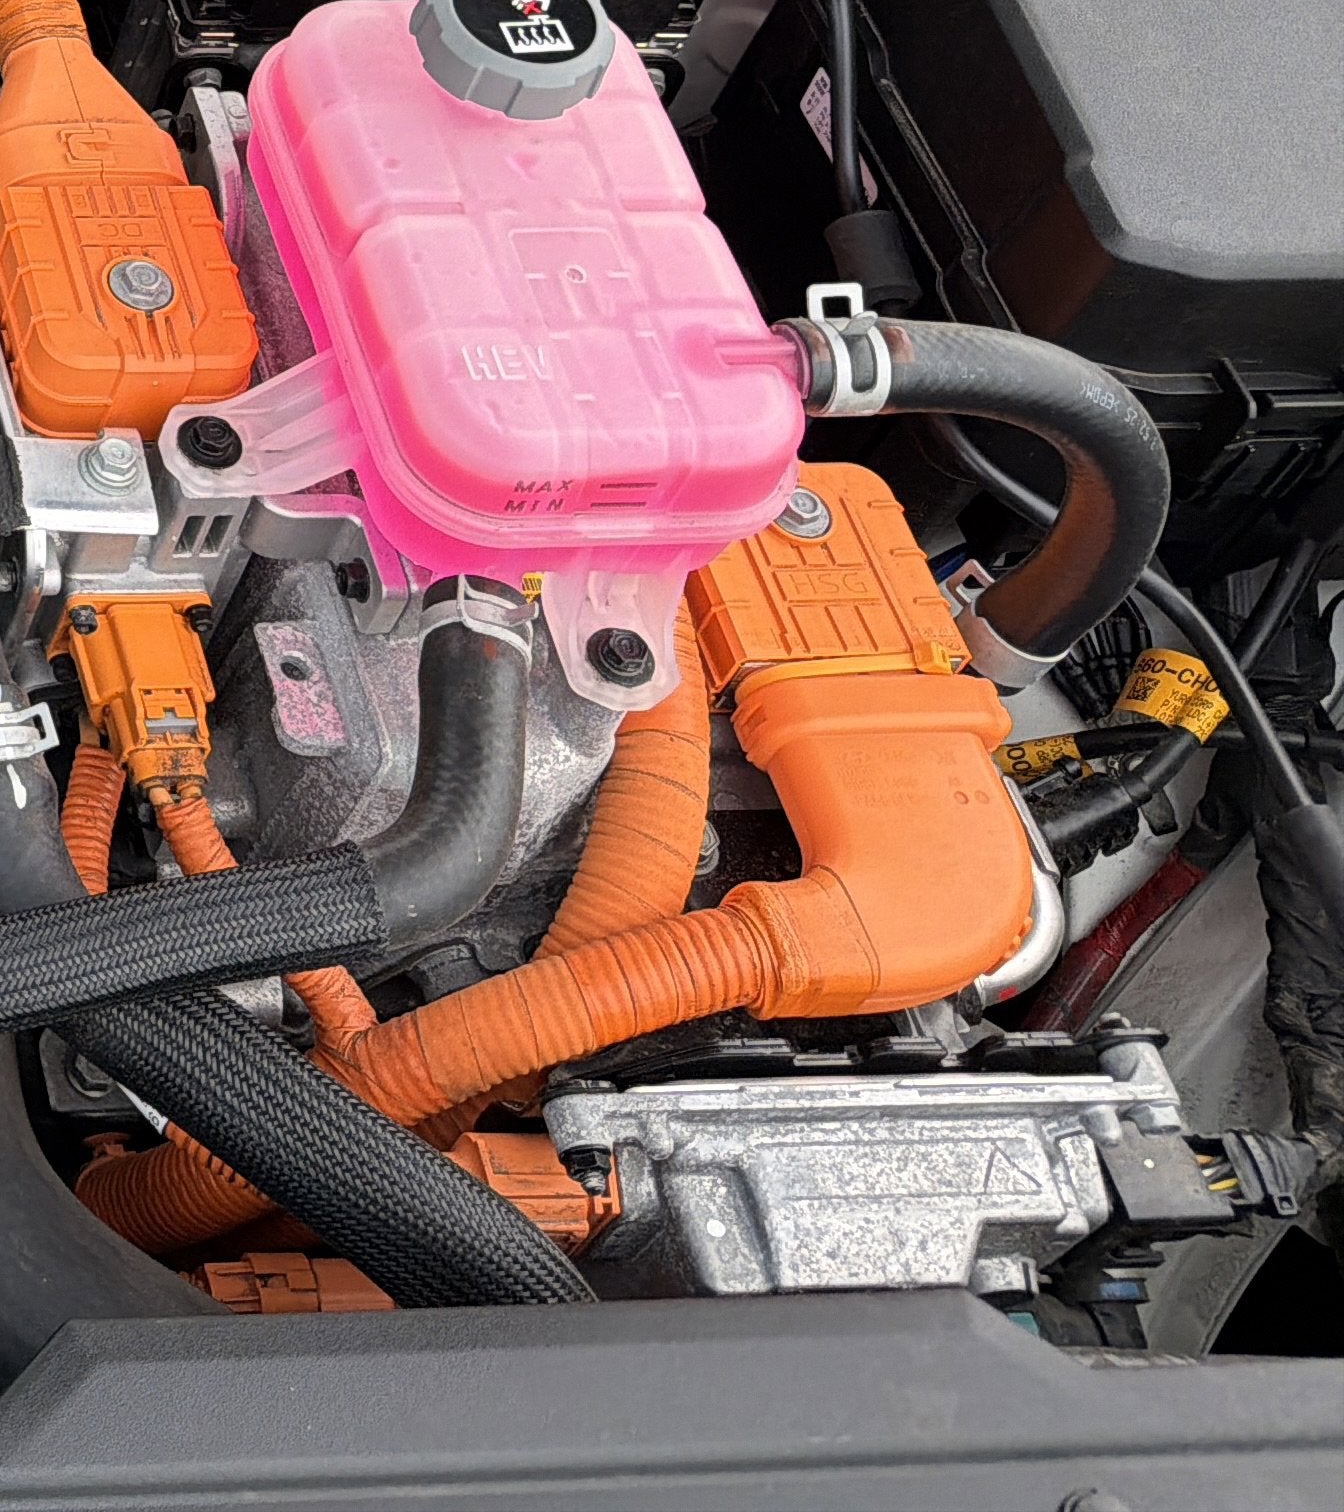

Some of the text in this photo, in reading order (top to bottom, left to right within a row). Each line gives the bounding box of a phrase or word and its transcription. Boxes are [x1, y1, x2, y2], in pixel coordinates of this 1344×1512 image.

[460, 344, 552, 382] HEV
[514, 479, 574, 495] MAX
[503, 498, 564, 513] MIN
[789, 571, 869, 595] HSG
